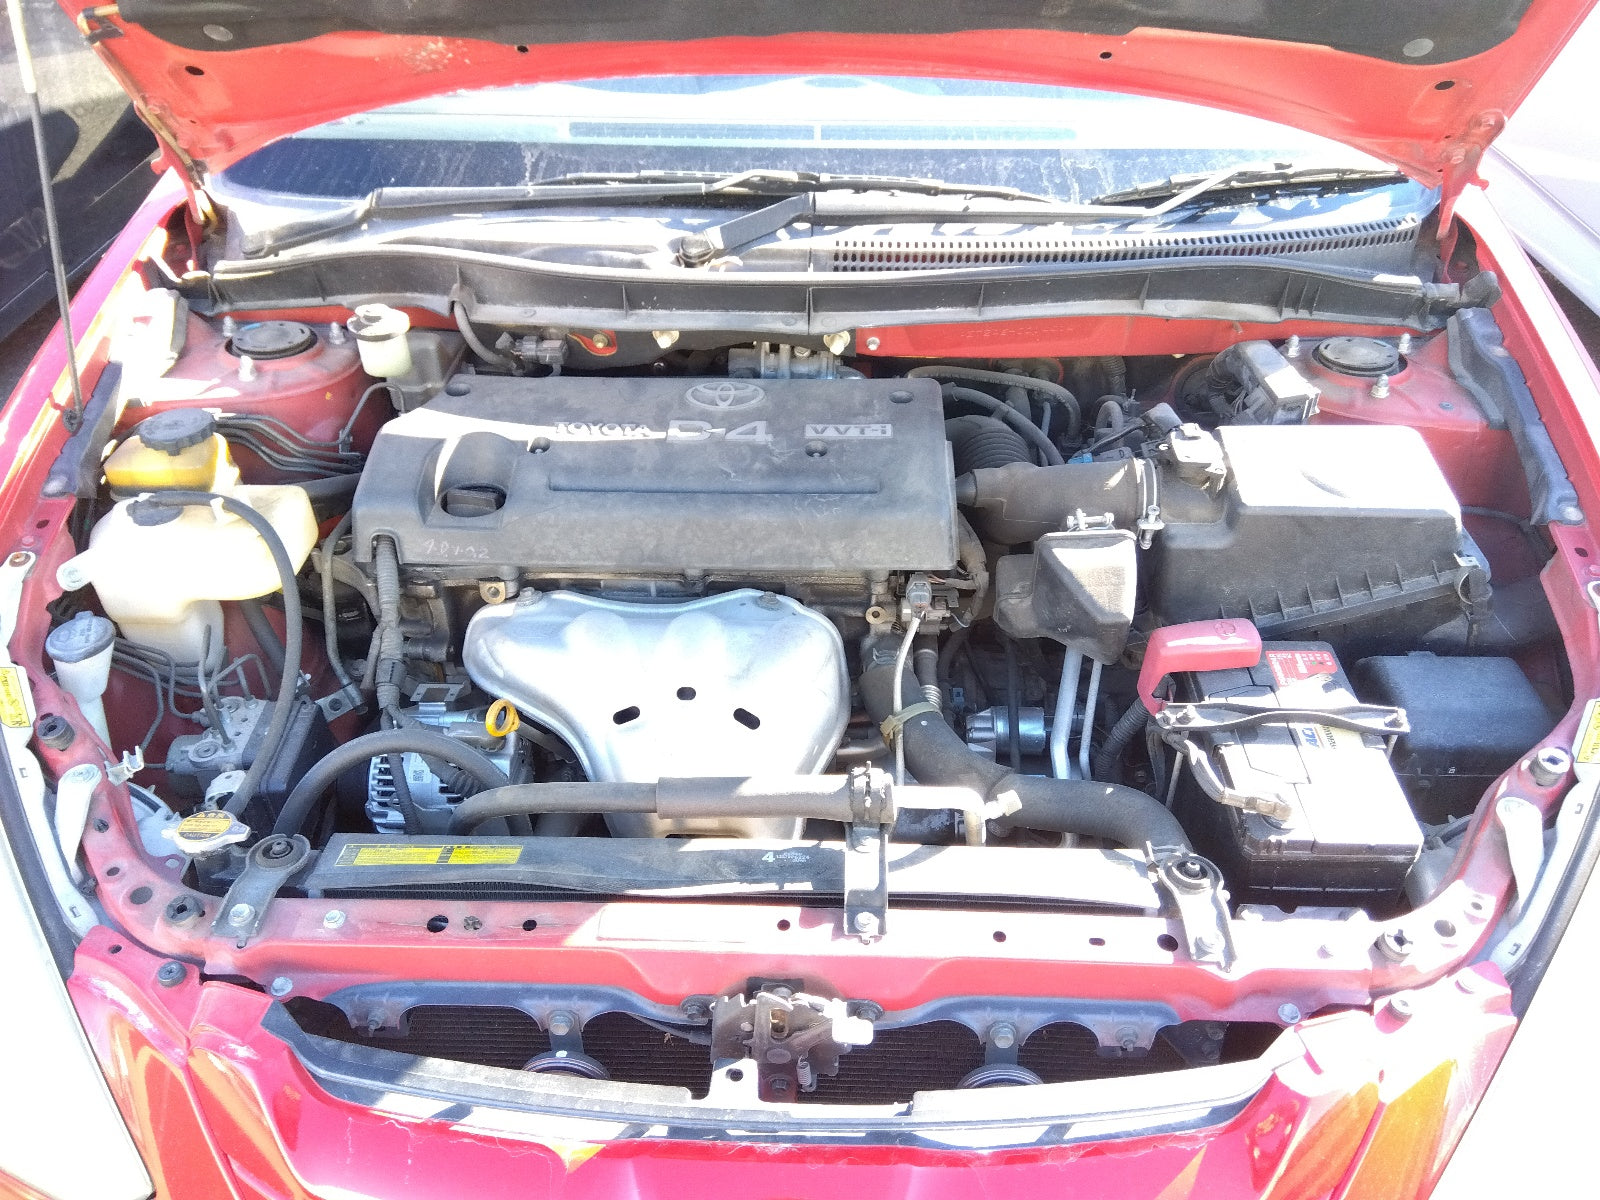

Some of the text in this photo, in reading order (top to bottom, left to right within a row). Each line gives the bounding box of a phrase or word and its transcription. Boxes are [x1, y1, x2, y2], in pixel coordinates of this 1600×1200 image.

[553, 419, 889, 442] TOYOTA D-4 VVT-i
